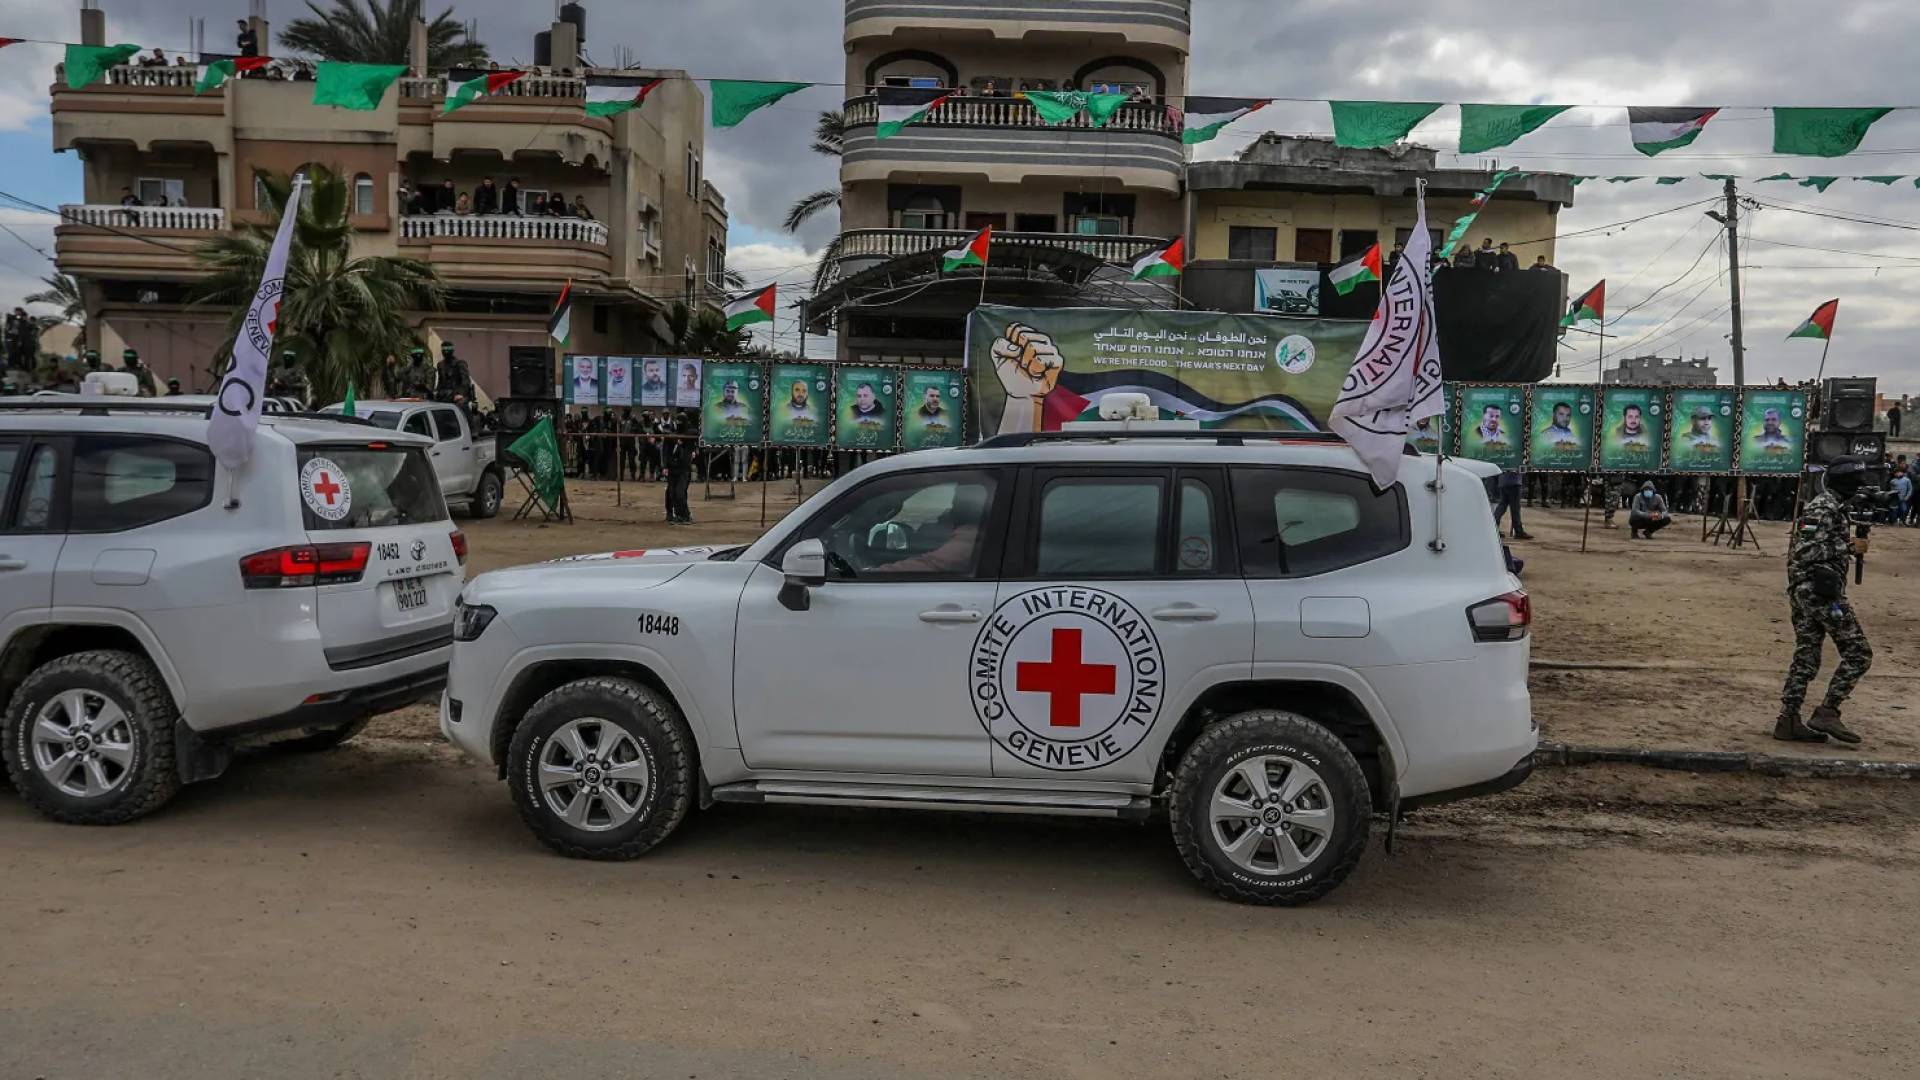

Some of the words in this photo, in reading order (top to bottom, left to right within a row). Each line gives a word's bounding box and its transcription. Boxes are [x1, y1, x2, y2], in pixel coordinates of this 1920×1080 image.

[257, 279, 284, 301] COM
[246, 307, 272, 357] GENEV
[1093, 327, 1134, 342] التالي
[1136, 329, 1166, 342] اليوم
[1168, 331, 1187, 342] نحن
[1198, 331, 1246, 344] الطوفان
[1247, 335, 1267, 346] نحن
[1130, 345, 1152, 353] היום
[1154, 345, 1184, 355] אנחנו
[1237, 349, 1266, 359] אנחנו
[1121, 357, 1138, 366] THE
[1139, 358, 1167, 368] FLOOD
[1175, 360, 1192, 369] THE
[1223, 362, 1245, 371] NEXT
[1246, 363, 1265, 372] DAY
[377, 542, 400, 561] 18452
[637, 613, 679, 636] 18448
[975, 615, 1016, 721] COMITE
[1021, 588, 1159, 728] INTERNATIONAL
[1007, 729, 1123, 766] GENEVE
